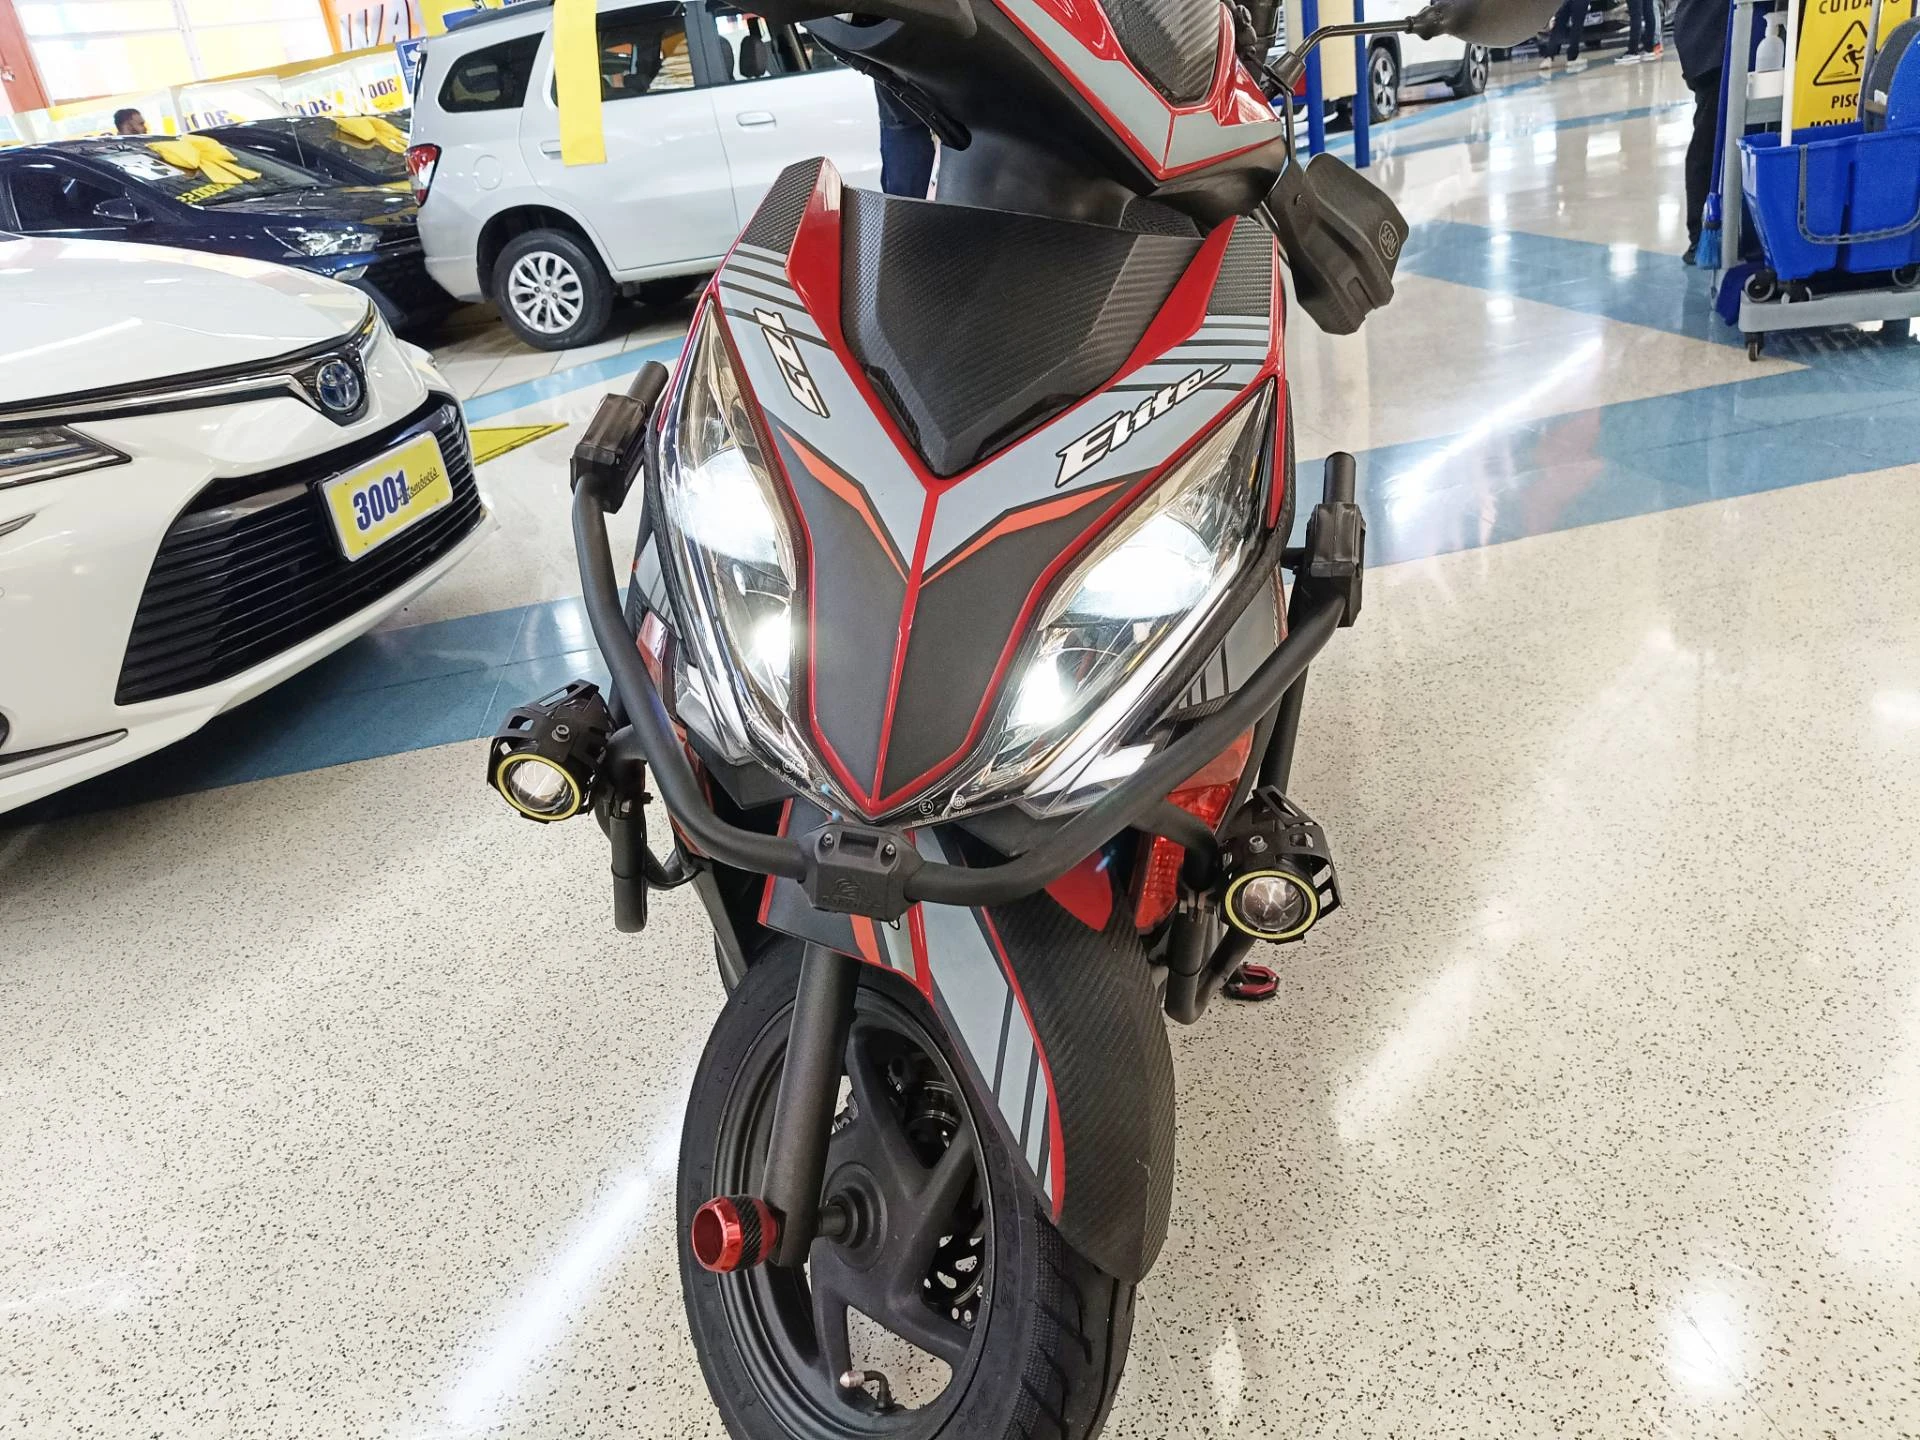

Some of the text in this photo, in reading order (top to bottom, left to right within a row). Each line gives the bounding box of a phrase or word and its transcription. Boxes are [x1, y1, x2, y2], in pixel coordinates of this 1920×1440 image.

[753, 307, 831, 418] 125
[1056, 363, 1231, 488] Elite
[353, 469, 410, 530] 3001
